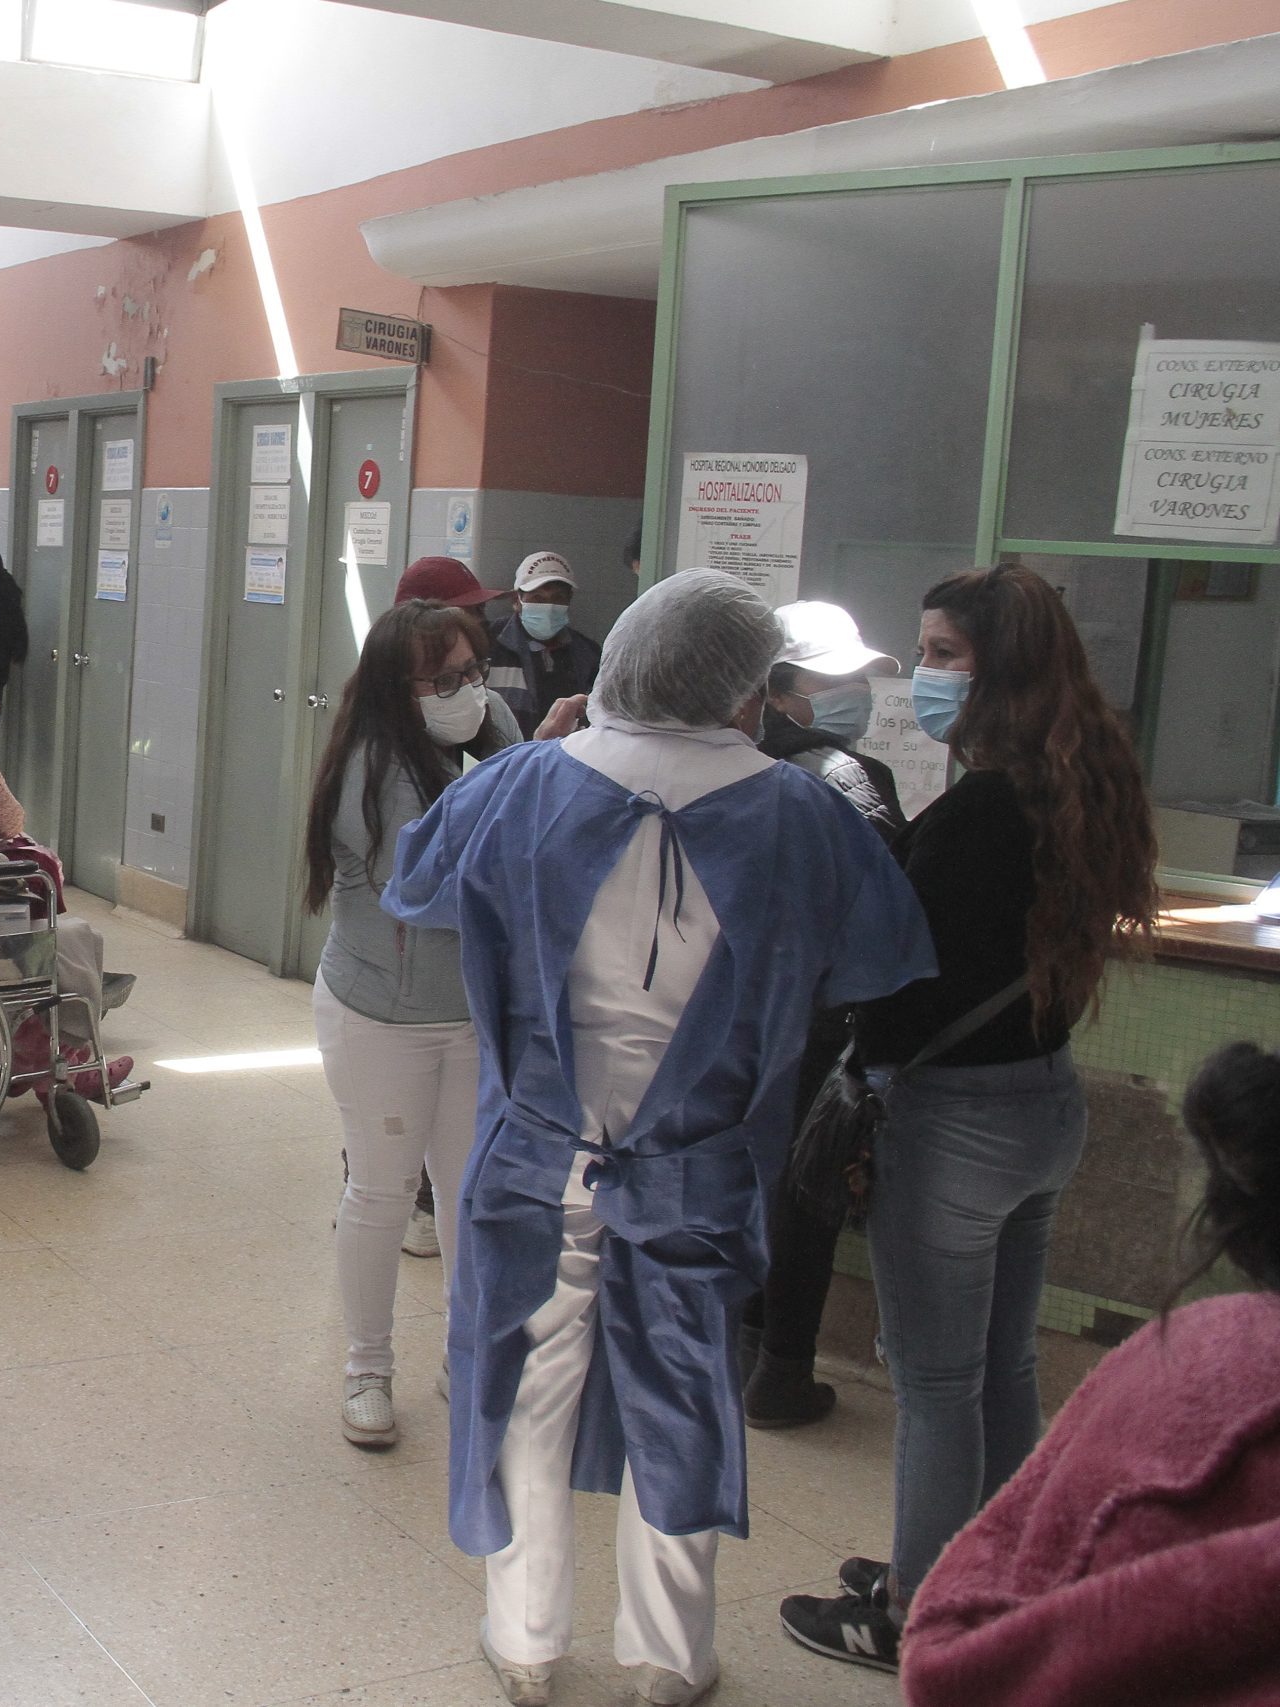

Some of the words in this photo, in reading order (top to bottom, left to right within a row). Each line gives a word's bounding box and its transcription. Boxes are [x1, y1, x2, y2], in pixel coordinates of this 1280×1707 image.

[364, 319, 418, 341] CIRUGIA
[365, 336, 416, 358] VARONES
[1156, 359, 1198, 373] CONS.
[1169, 381, 1261, 403] CIRUGIA
[1160, 410, 1264, 430] MUJERES
[690, 459, 714, 472] HOSPITAL
[715, 460, 741, 473] REGIONAL
[742, 460, 769, 473] HONORIO
[769, 461, 797, 474] DELGADO
[1144, 448, 1186, 462] CONS.
[1191, 449, 1269, 465] EXTERNO
[49, 474, 55, 487] 7
[365, 471, 373, 489] 7
[1157, 471, 1249, 494] CIRUGIA
[698, 481, 782, 503] HOSPITALIZACION
[1149, 499, 1251, 521] VARONES
[840, 1622, 878, 1655] N
